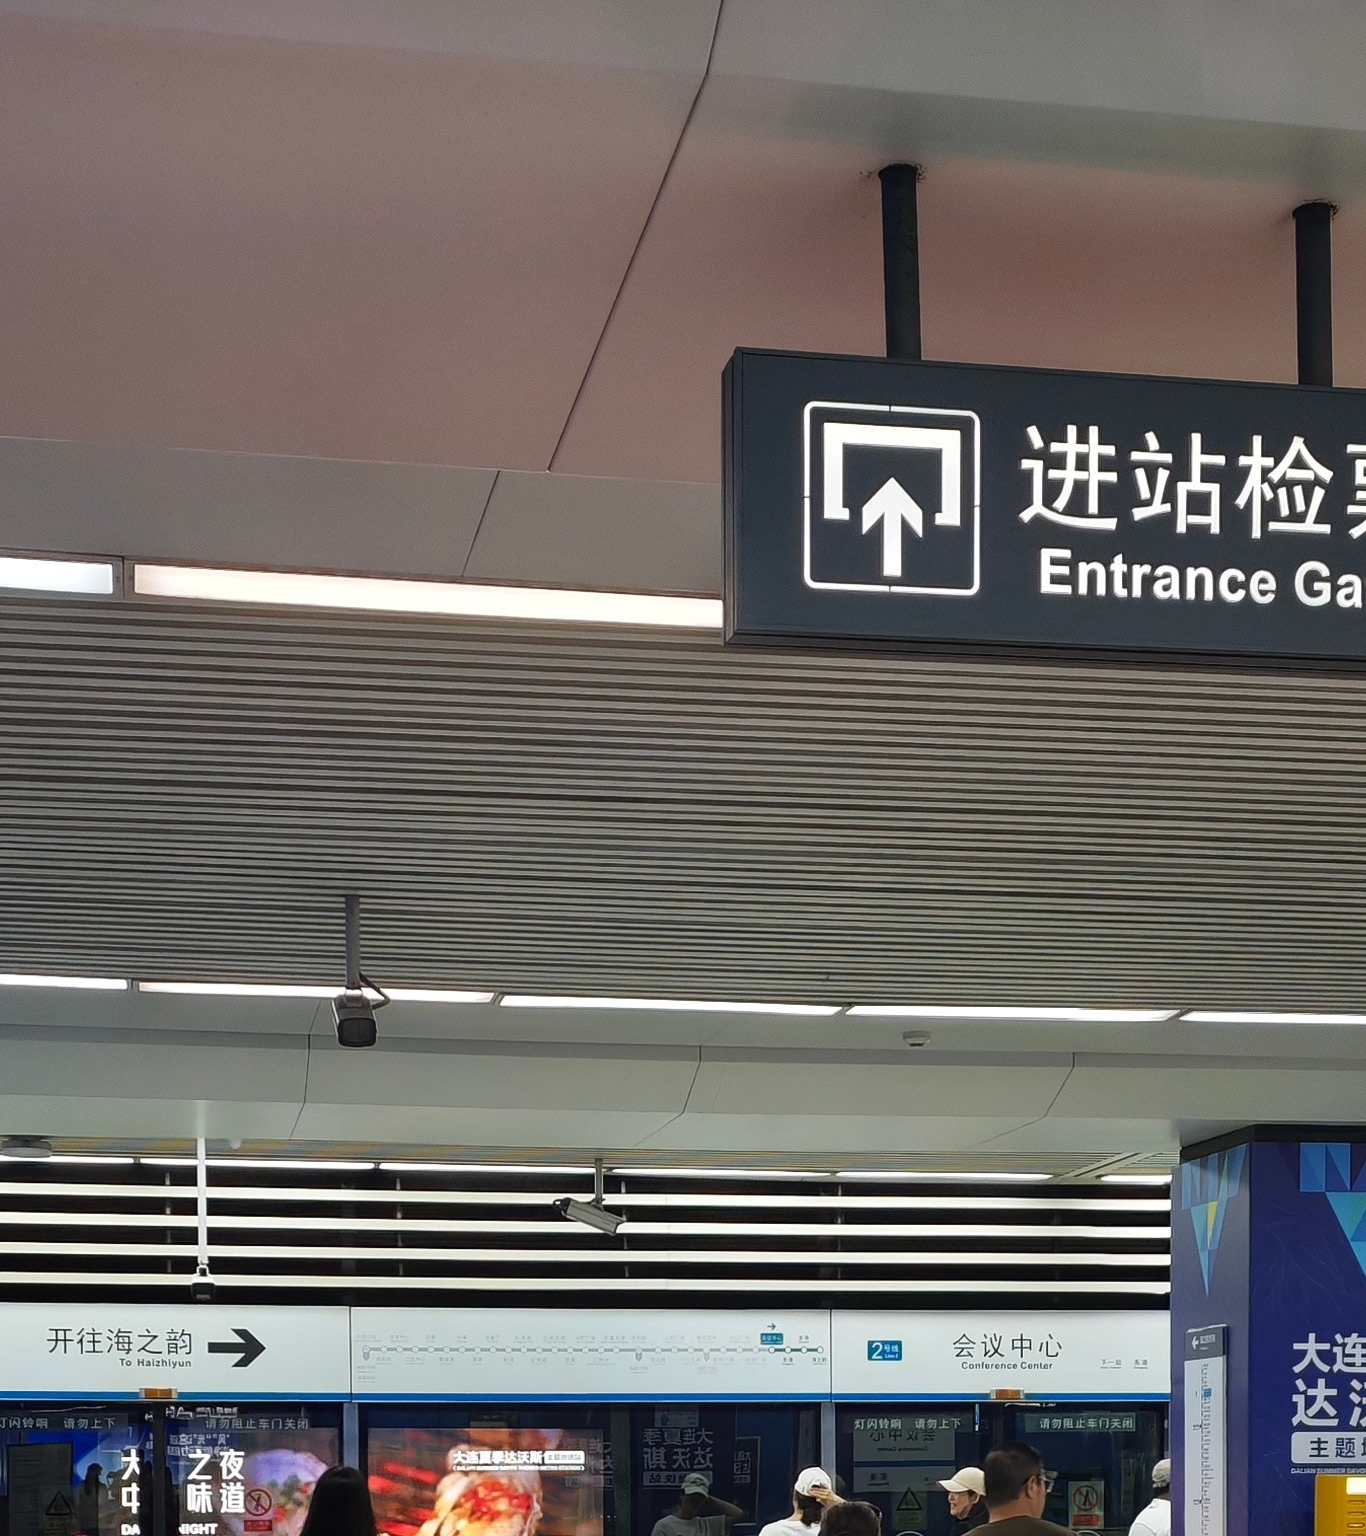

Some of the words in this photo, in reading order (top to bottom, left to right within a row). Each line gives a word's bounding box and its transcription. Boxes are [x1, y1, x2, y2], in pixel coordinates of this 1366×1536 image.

[1039, 548, 1277, 605] Entrance
[46, 1327, 192, 1356] 开往海之韵
[953, 1333, 1062, 1358] 会议中心
[119, 1358, 133, 1367] To
[137, 1358, 192, 1369] Haizhiyun
[961, 1361, 1018, 1370] Conference
[1020, 1361, 1052, 1370] Center
[915, 1418, 962, 1430] 请勿上下
[1040, 1418, 1133, 1430] 请勿阻止车门关闭
